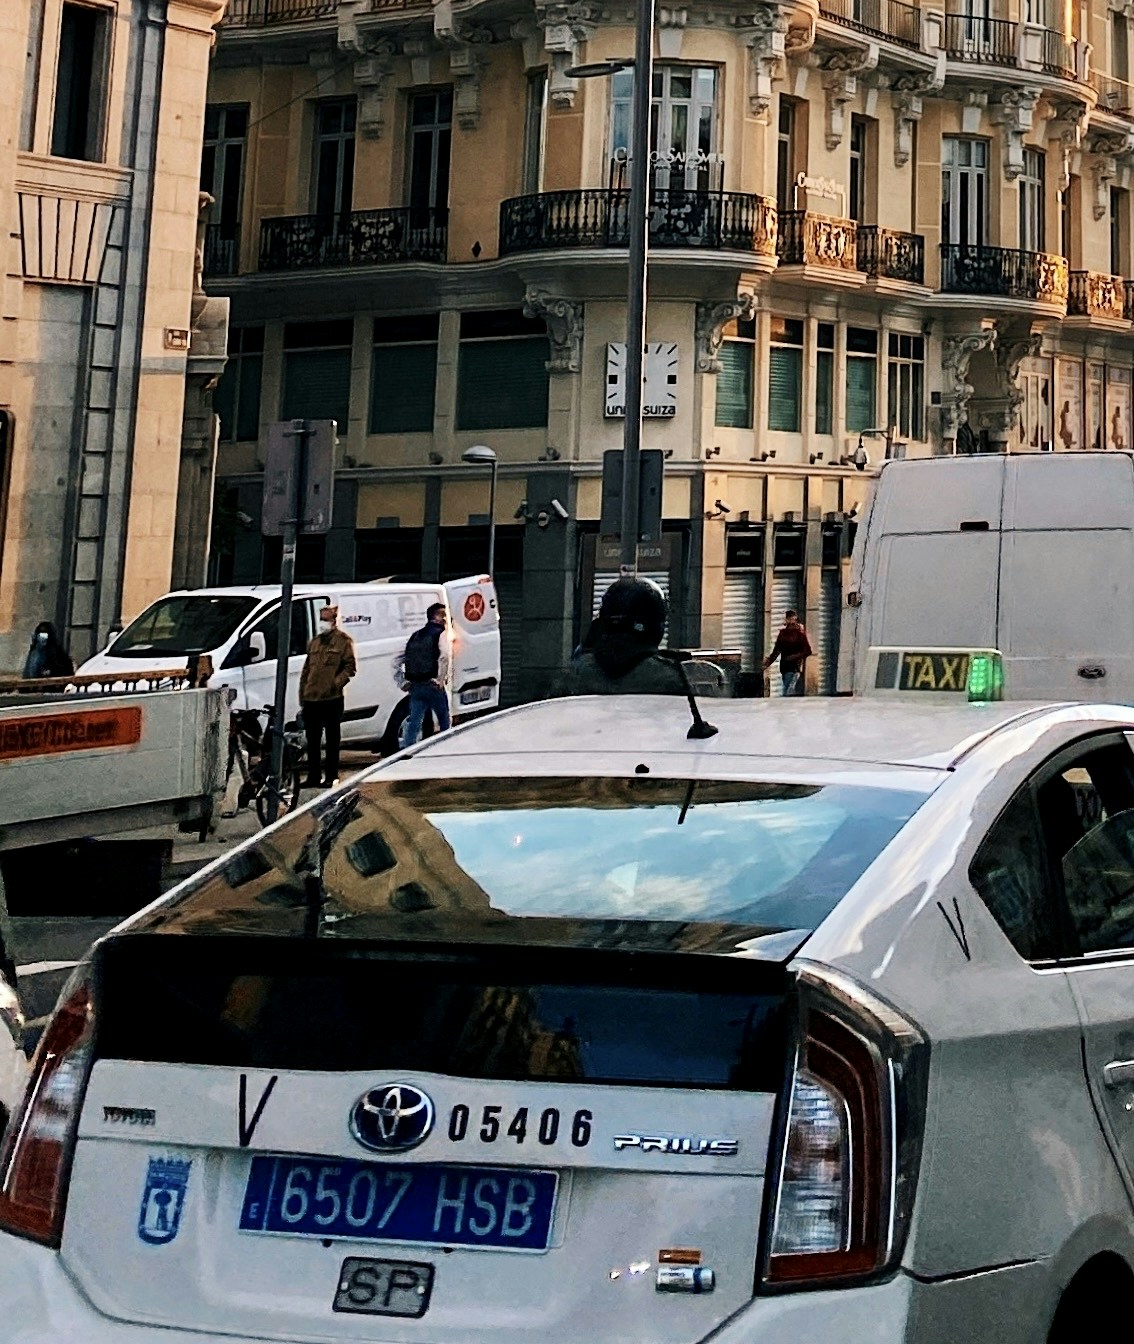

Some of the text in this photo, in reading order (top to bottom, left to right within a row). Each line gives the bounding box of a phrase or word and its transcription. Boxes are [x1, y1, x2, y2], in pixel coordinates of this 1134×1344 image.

[642, 405, 676, 415] suiza
[904, 655, 968, 688] TAXI
[937, 896, 971, 961] V
[239, 1073, 278, 1147] V
[448, 1104, 593, 1147] 05406
[612, 1133, 738, 1156] PRIUS
[280, 1165, 536, 1237] 6507 HSB
[348, 1266, 420, 1308] SP
